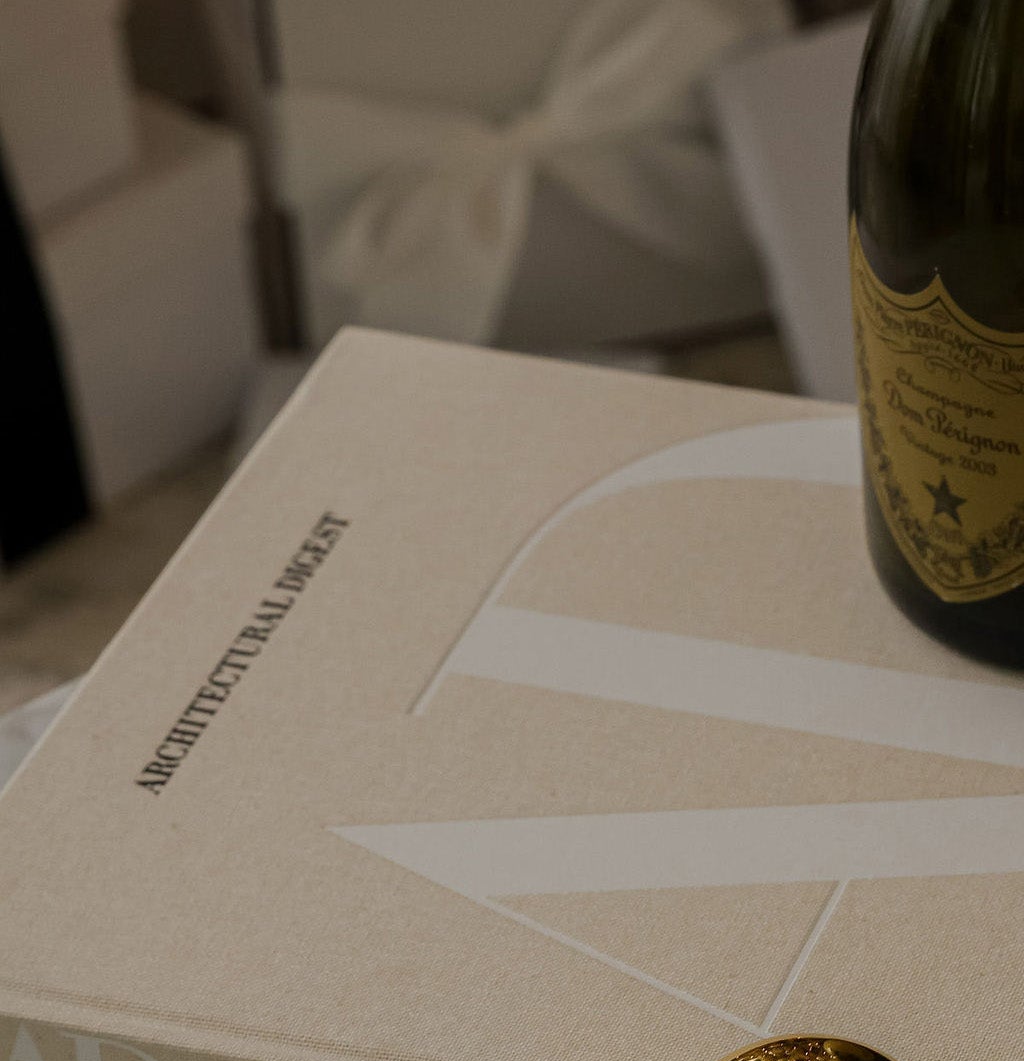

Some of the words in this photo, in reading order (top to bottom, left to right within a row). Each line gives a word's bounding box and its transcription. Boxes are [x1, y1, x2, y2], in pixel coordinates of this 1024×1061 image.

[882, 379, 925, 426] Dom
[926, 406, 1022, 456] Pérignon
[896, 366, 996, 419] Champagne
[134, 597, 296, 796] ARCHITECTURAL
[273, 510, 351, 593] DIGEST
